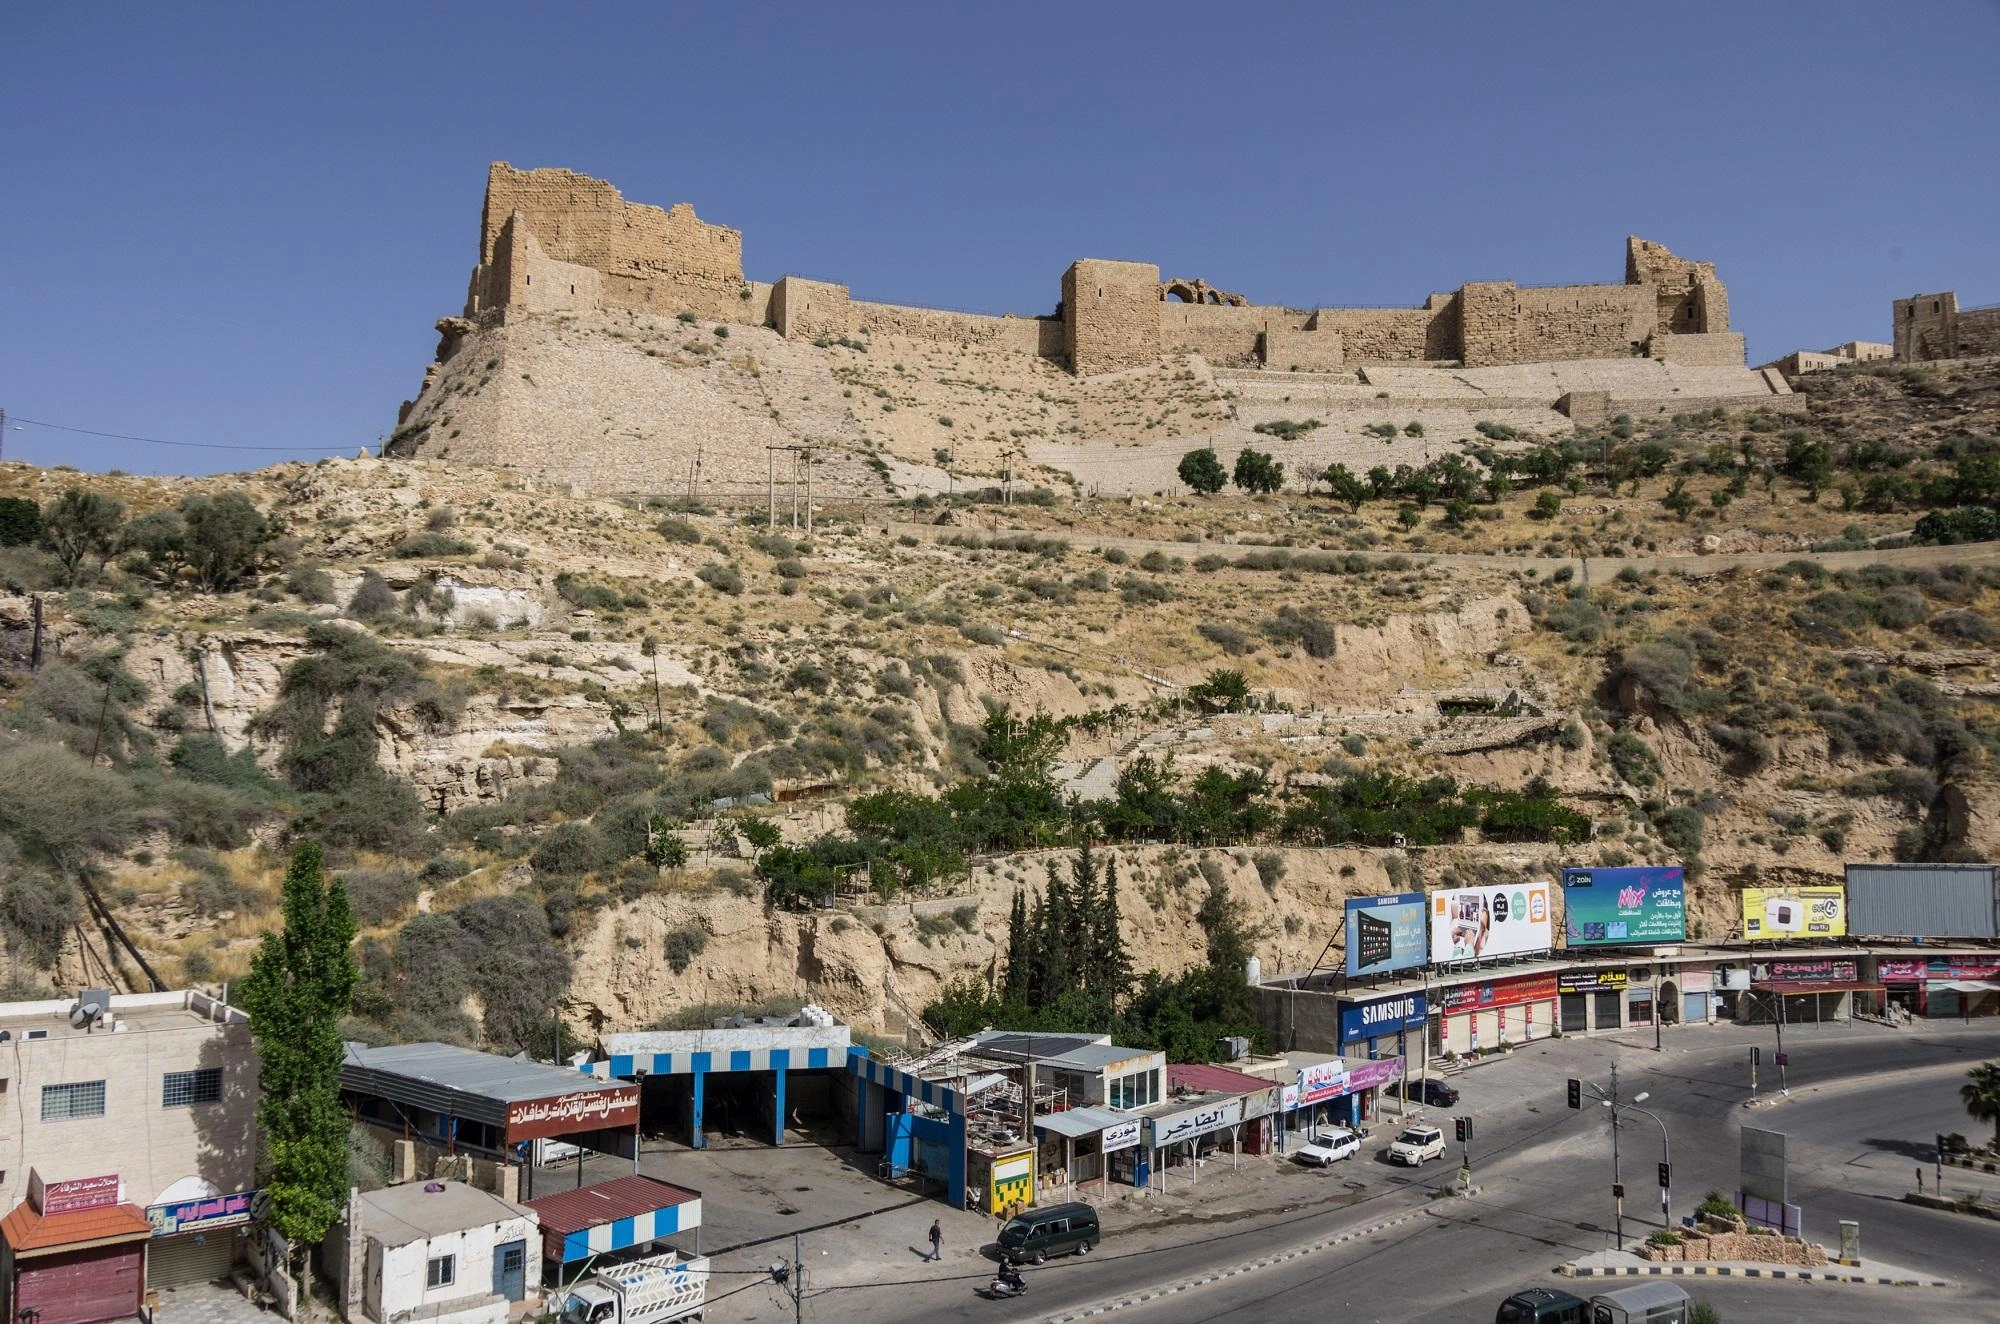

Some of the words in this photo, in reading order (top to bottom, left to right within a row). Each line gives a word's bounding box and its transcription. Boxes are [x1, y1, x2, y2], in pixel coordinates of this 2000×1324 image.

[1652, 888, 1672, 898] عروض
[1672, 889, 1681, 898] مع
[1377, 896, 1399, 906] SAMSUNG
[1598, 971, 1626, 984] سلام
[1160, 1109, 1224, 1141] الفاخر
[1106, 1125, 1137, 1143] فوزي
[82, 1182, 97, 1191] سعيد
[97, 1178, 117, 1187] محلات
